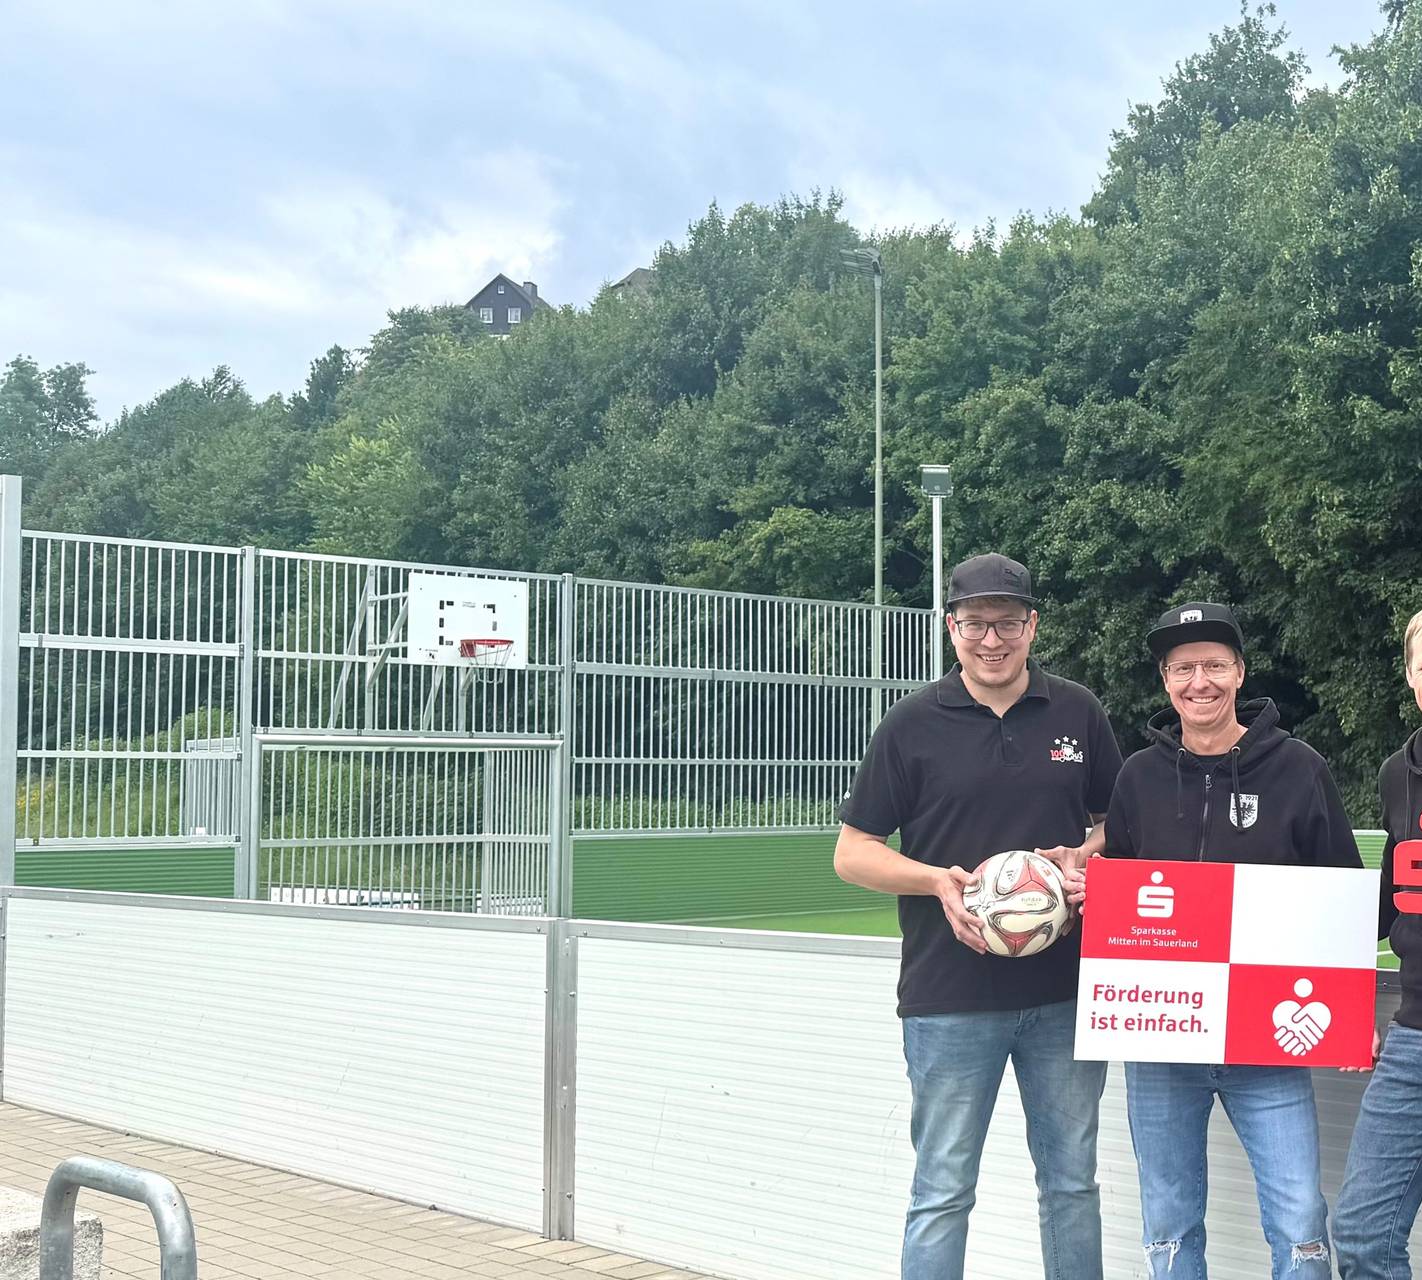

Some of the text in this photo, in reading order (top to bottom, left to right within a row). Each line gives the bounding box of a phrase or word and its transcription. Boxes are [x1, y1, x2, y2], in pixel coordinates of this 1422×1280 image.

[1130, 925, 1177, 937] Sparkasse
[1108, 937, 1199, 948] Mitten im Sauerland
[1093, 983, 1204, 1010] Förderung
[1090, 1011, 1209, 1034] ist einfach.
